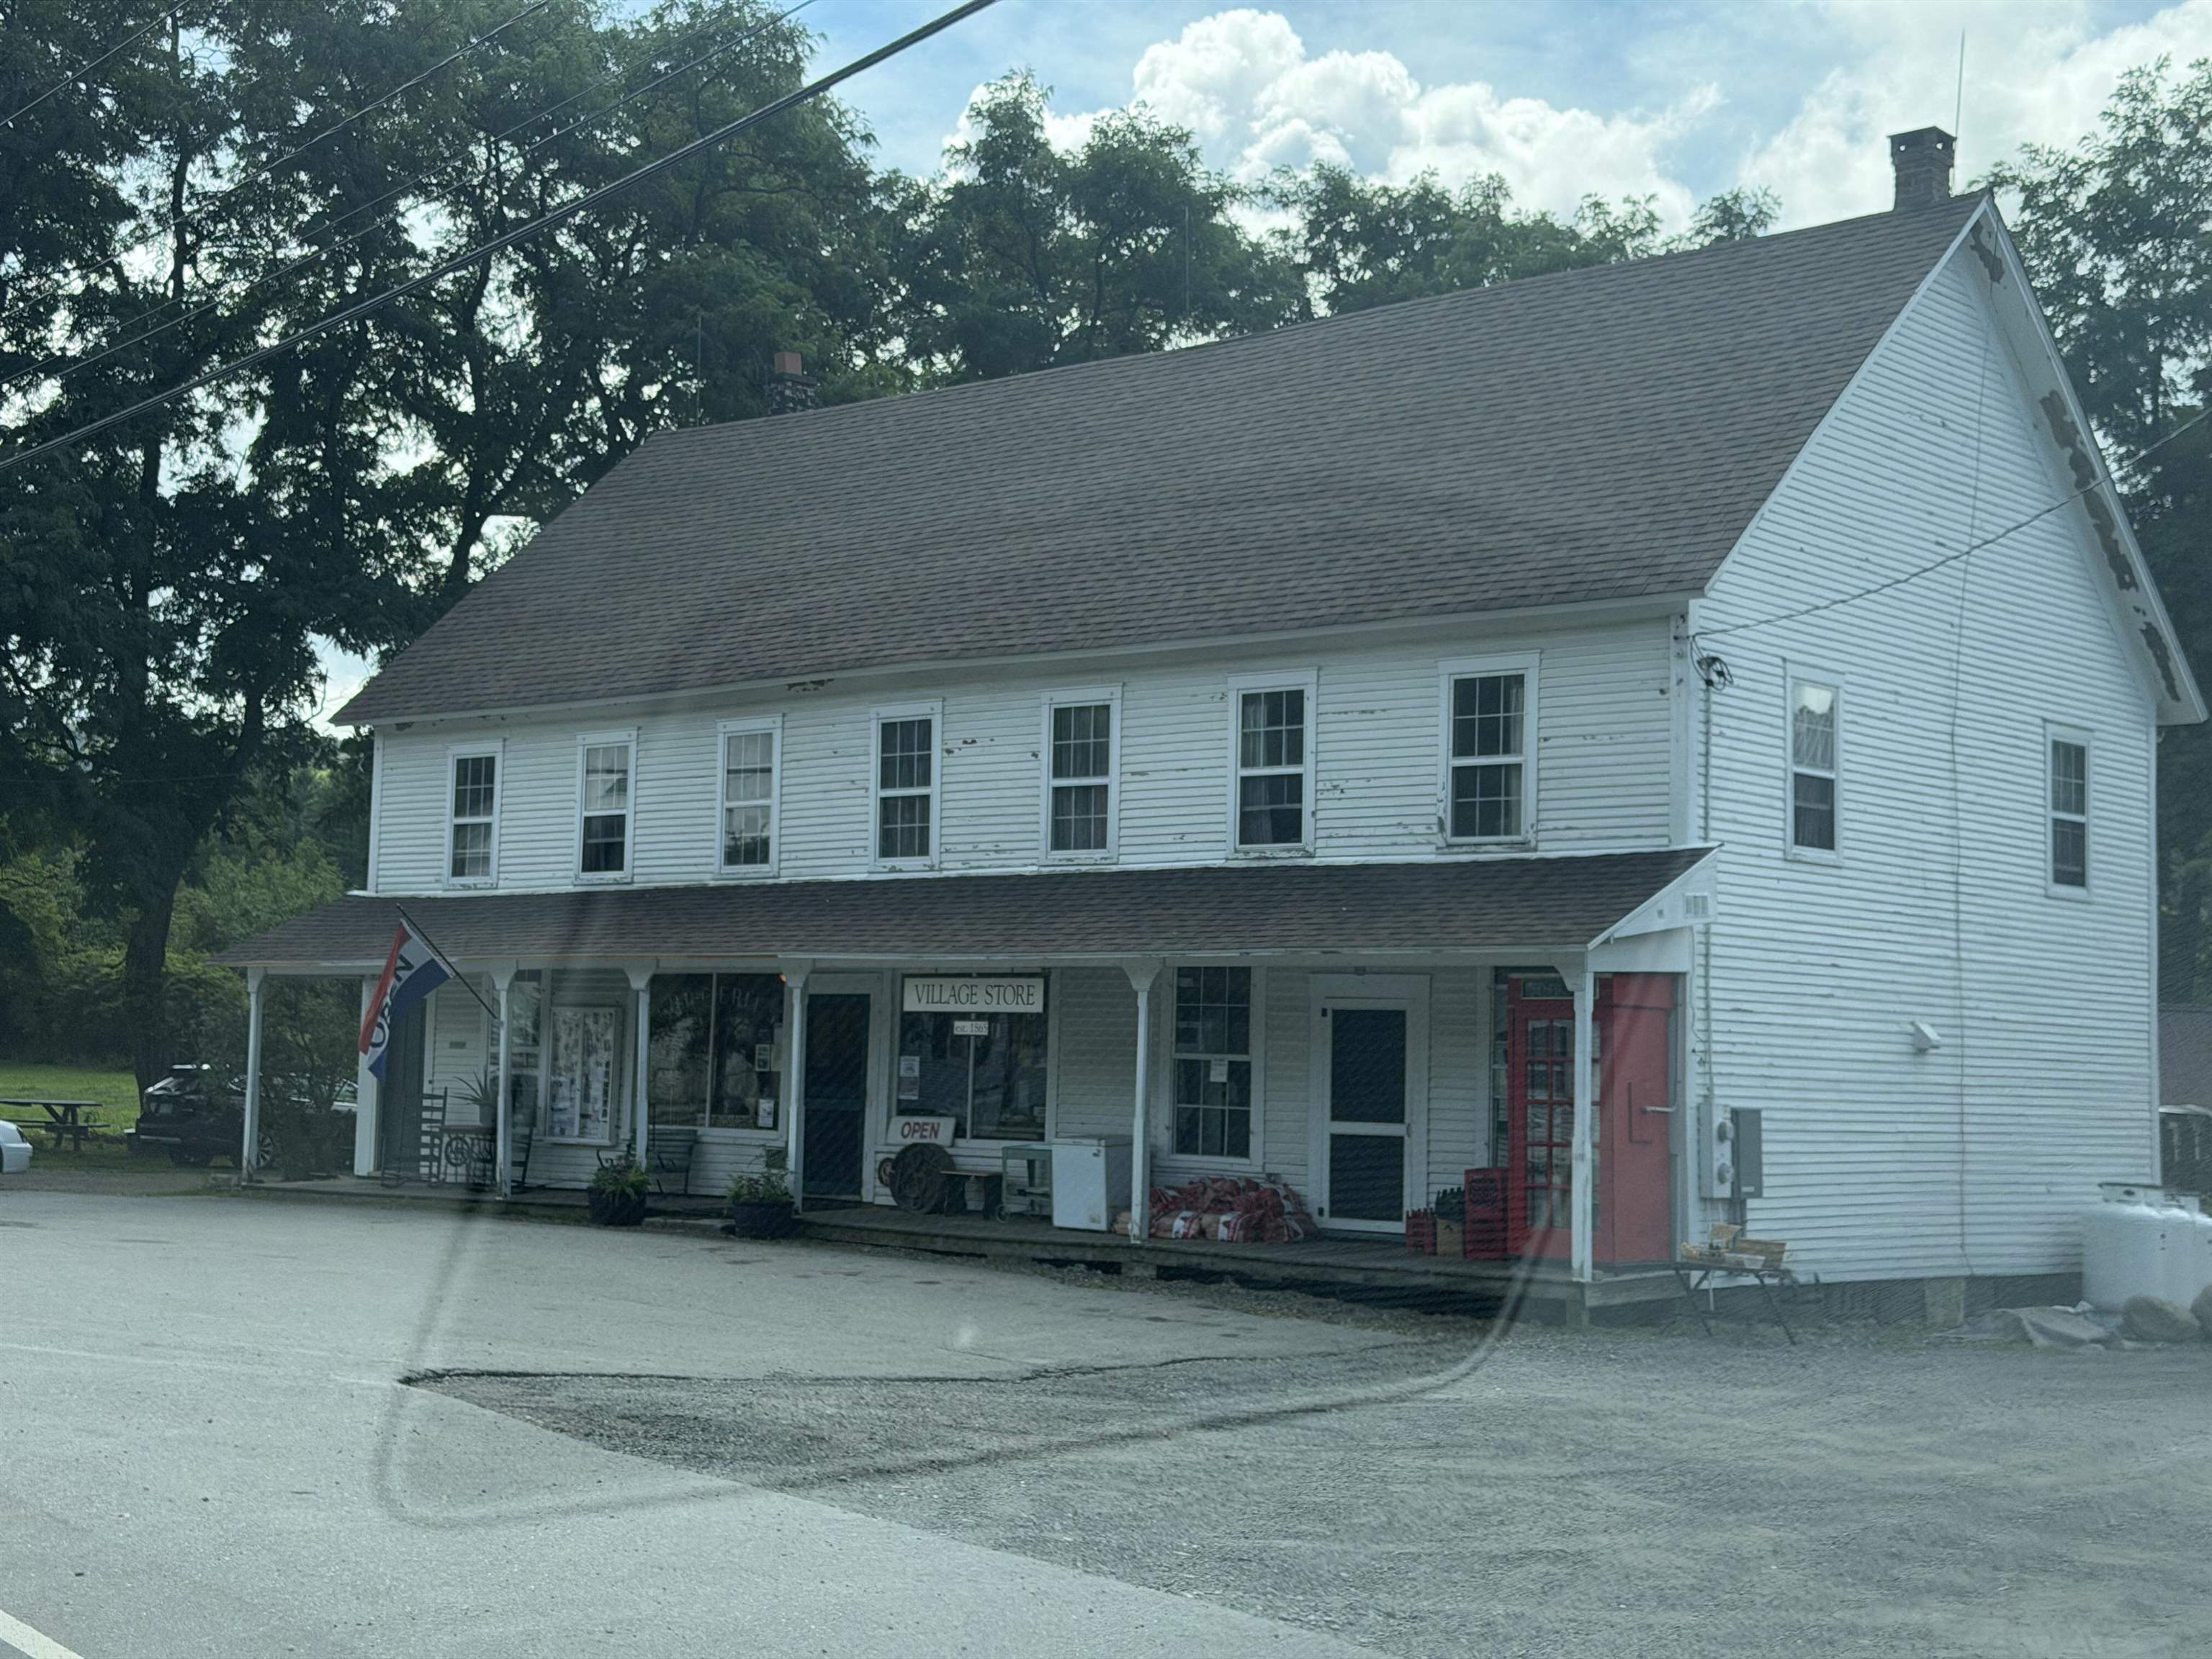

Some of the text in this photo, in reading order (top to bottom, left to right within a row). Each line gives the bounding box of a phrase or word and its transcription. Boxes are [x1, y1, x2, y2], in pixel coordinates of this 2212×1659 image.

[370, 954, 415, 1048] OPN
[914, 984, 1035, 1005] VILLAGE STORE
[901, 1121, 940, 1139] OPEN
